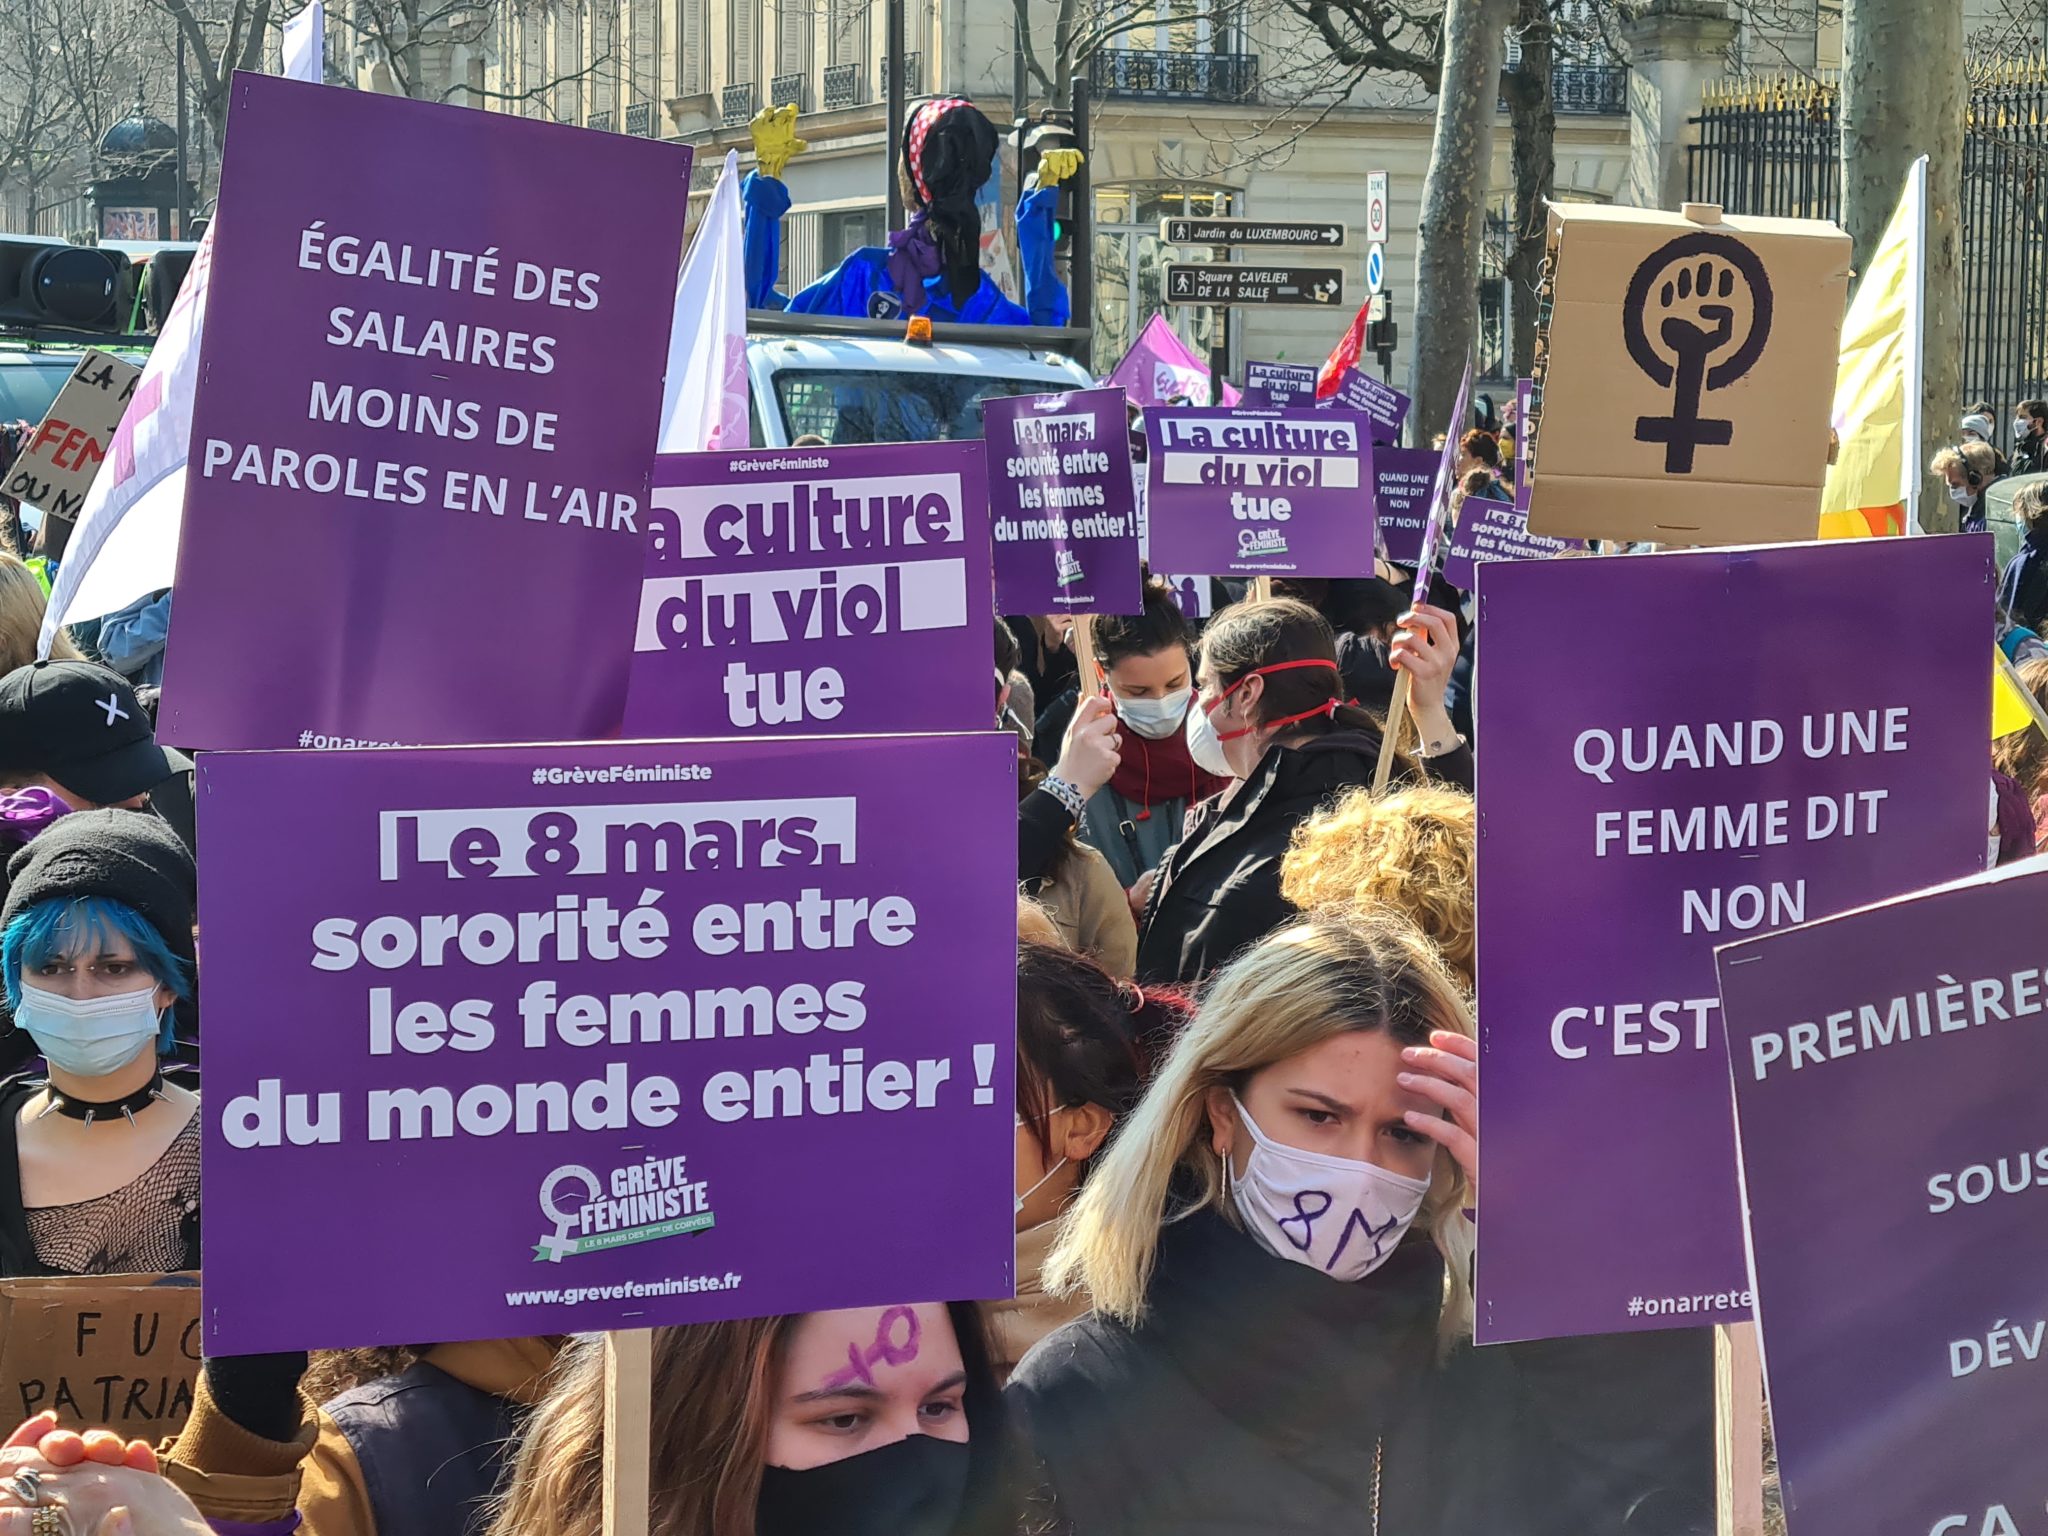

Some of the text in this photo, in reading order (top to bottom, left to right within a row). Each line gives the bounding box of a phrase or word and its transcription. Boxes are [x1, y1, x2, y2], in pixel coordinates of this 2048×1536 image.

[1194, 227, 1318, 241] Jardin du LUXEMBOURG
[298, 221, 601, 311] ÉGALITÉ DES
[1197, 270, 1288, 285] Square CAVELIER
[1197, 285, 1269, 299] DE LA SALLE
[326, 306, 557, 375] SALAIRES
[75, 354, 114, 390] LA
[1253, 366, 1311, 381] La culture
[1261, 379, 1301, 392] du viol
[1270, 391, 1290, 402] tue
[308, 381, 559, 452] MOINS DE
[1014, 420, 1033, 444] Le
[1034, 419, 1044, 444] 8
[1167, 421, 1350, 451] La culture
[203, 438, 427, 505] PAROLES
[442, 471, 505, 516] EN
[729, 457, 830, 473] #GrèveFéministe
[1006, 448, 1060, 478] sororité
[1063, 448, 1109, 476] entre
[1200, 455, 1322, 488] du viol
[1379, 472, 1429, 484] QUAND UNE
[1018, 482, 1105, 509] les femmes
[1230, 491, 1292, 521] tue
[1380, 486, 1425, 497] FEMME DIT
[1389, 500, 1410, 509] NON
[648, 483, 952, 560] a culture
[994, 515, 1019, 542] du
[1021, 513, 1069, 540] monde
[1071, 511, 1125, 539] entier
[1127, 511, 1135, 537] !
[1379, 516, 1426, 529] EST NON !
[1487, 510, 1505, 525] Le
[1507, 514, 1517, 526] 8
[1451, 545, 1469, 558] du
[1475, 535, 1496, 549] les
[1529, 534, 1566, 550] entre
[656, 565, 901, 650] du viol
[723, 661, 846, 728] tue
[1573, 706, 1909, 783] QUAND UNE
[532, 764, 713, 785] #GrèveFéministe
[1595, 788, 1889, 857] FEMME DIT
[397, 815, 502, 878] Le
[524, 811, 581, 877] 8
[1682, 879, 1806, 934] NON
[311, 887, 917, 971] sororité entre
[368, 979, 868, 1057] les femmes
[1550, 997, 1721, 1060] C'EST
[1750, 968, 2048, 1081] PREMIÈRE
[221, 1043, 996, 1149] du monde entier !
[610, 1155, 688, 1199] GRÈVE
[579, 1181, 710, 1236] FÉMINISTE
[584, 1241, 596, 1249] LE
[603, 1233, 628, 1246] MARS
[628, 1230, 645, 1241] DES
[662, 1225, 674, 1233] DE
[674, 1216, 712, 1230] CORVÉES
[1278, 1188, 1399, 1272] 8M
[505, 1271, 743, 1307] www.grevefeministe.fr
[76, 1312, 202, 1360] FUC
[18, 1375, 195, 1423] PATRIA
